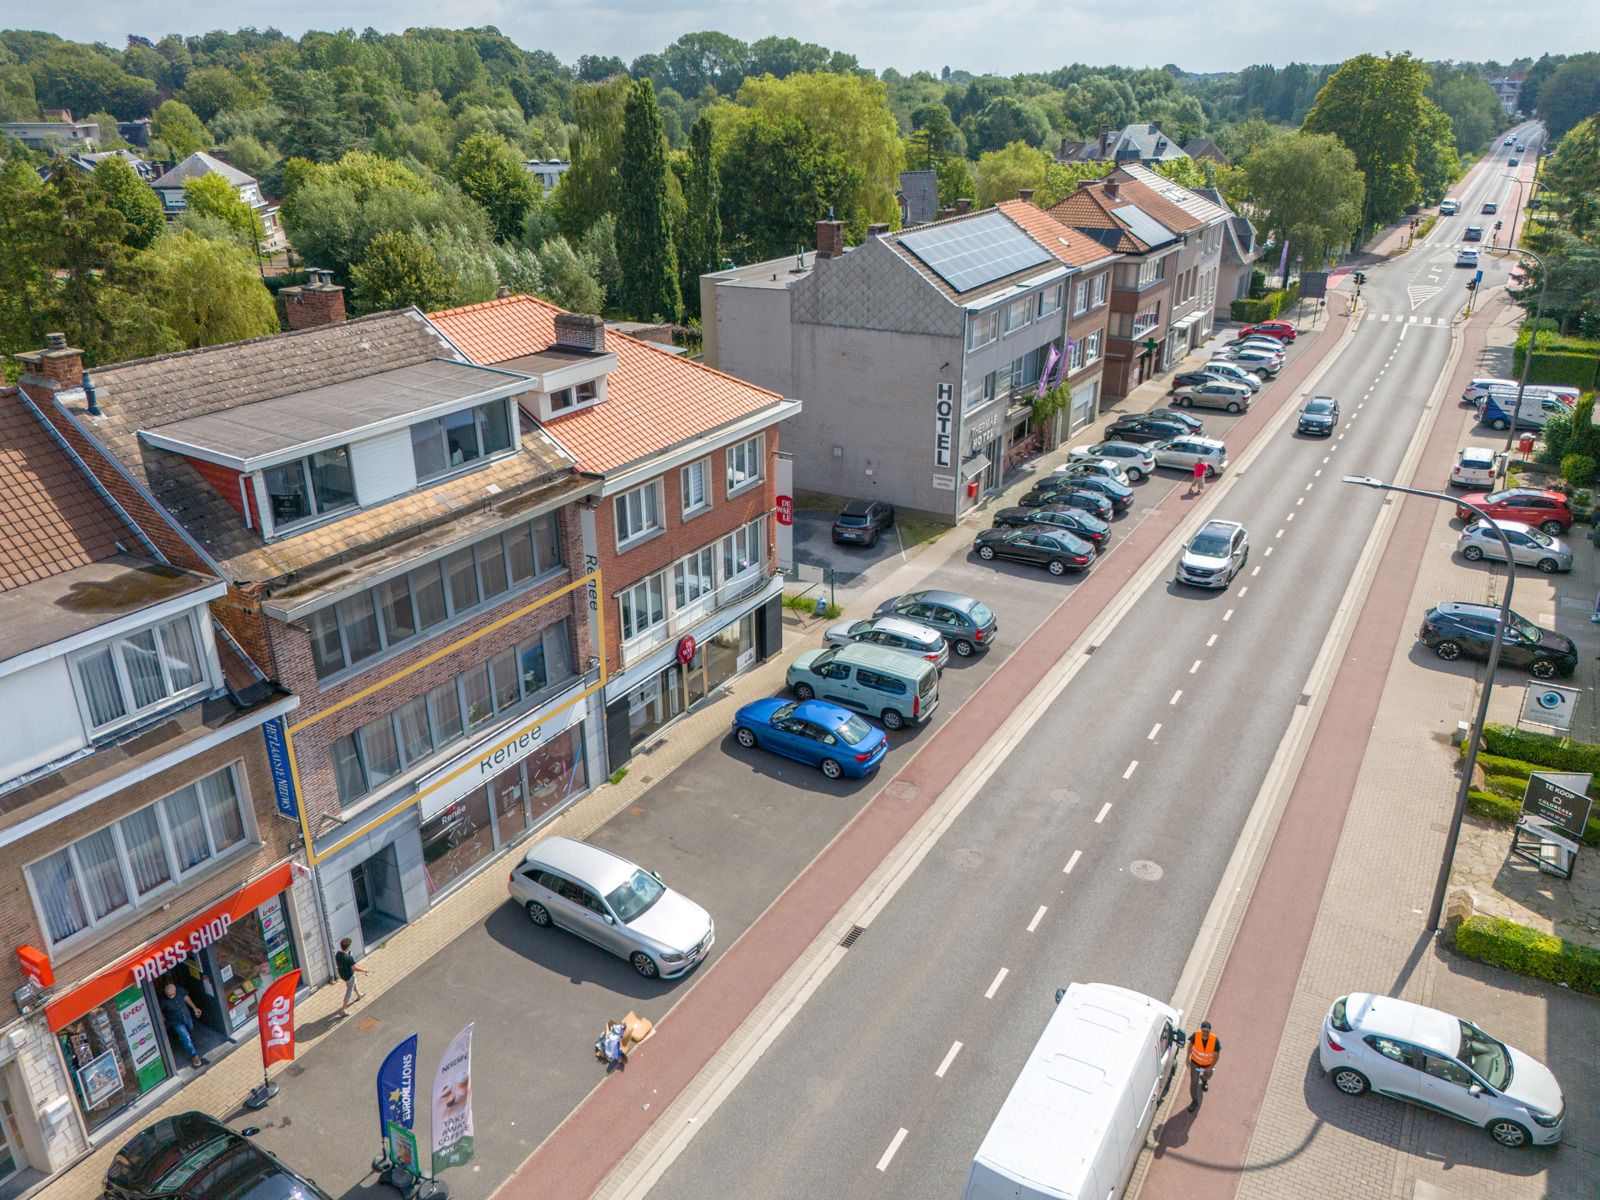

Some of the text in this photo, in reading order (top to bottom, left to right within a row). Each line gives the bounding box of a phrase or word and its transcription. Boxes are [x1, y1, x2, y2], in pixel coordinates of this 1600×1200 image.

[937, 383, 953, 467] HOTEL
[781, 499, 791, 508] DE
[1545, 782, 1575, 799] TE KOOP
[132, 912, 232, 989] PRESS SHOP
[401, 1053, 413, 1122] EUROMILLIONS
[441, 1121, 467, 1137] AWAY
[442, 1112, 467, 1128] TAKE
[438, 1124, 470, 1147] COFFEE
